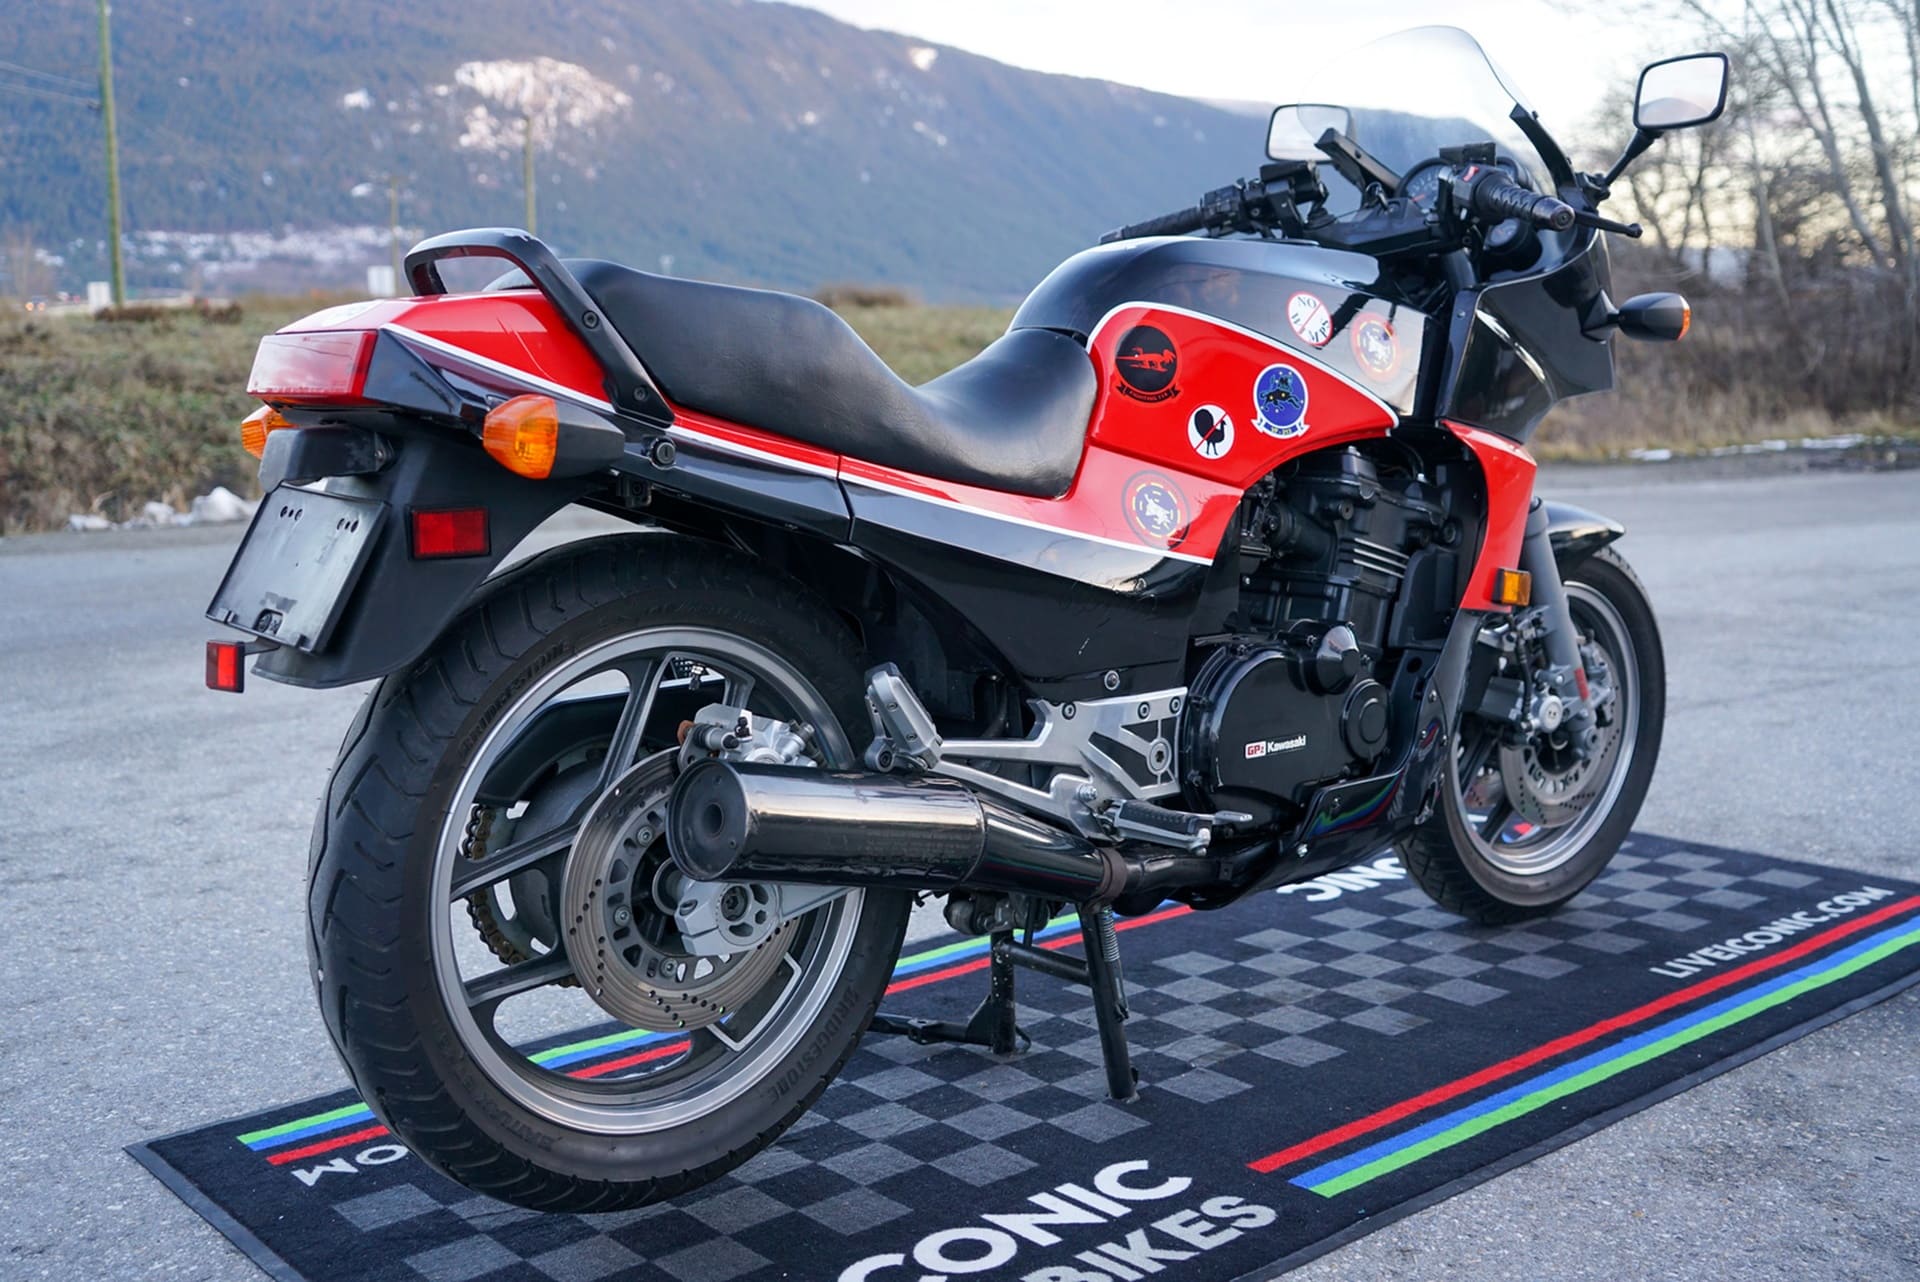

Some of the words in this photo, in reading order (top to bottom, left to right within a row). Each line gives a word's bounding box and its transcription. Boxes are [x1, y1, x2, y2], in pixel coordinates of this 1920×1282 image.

[1297, 296, 1317, 309] NO
[1267, 735, 1306, 753] Kawasaki
[1650, 885, 1896, 979] LIVEICONIC.COM
